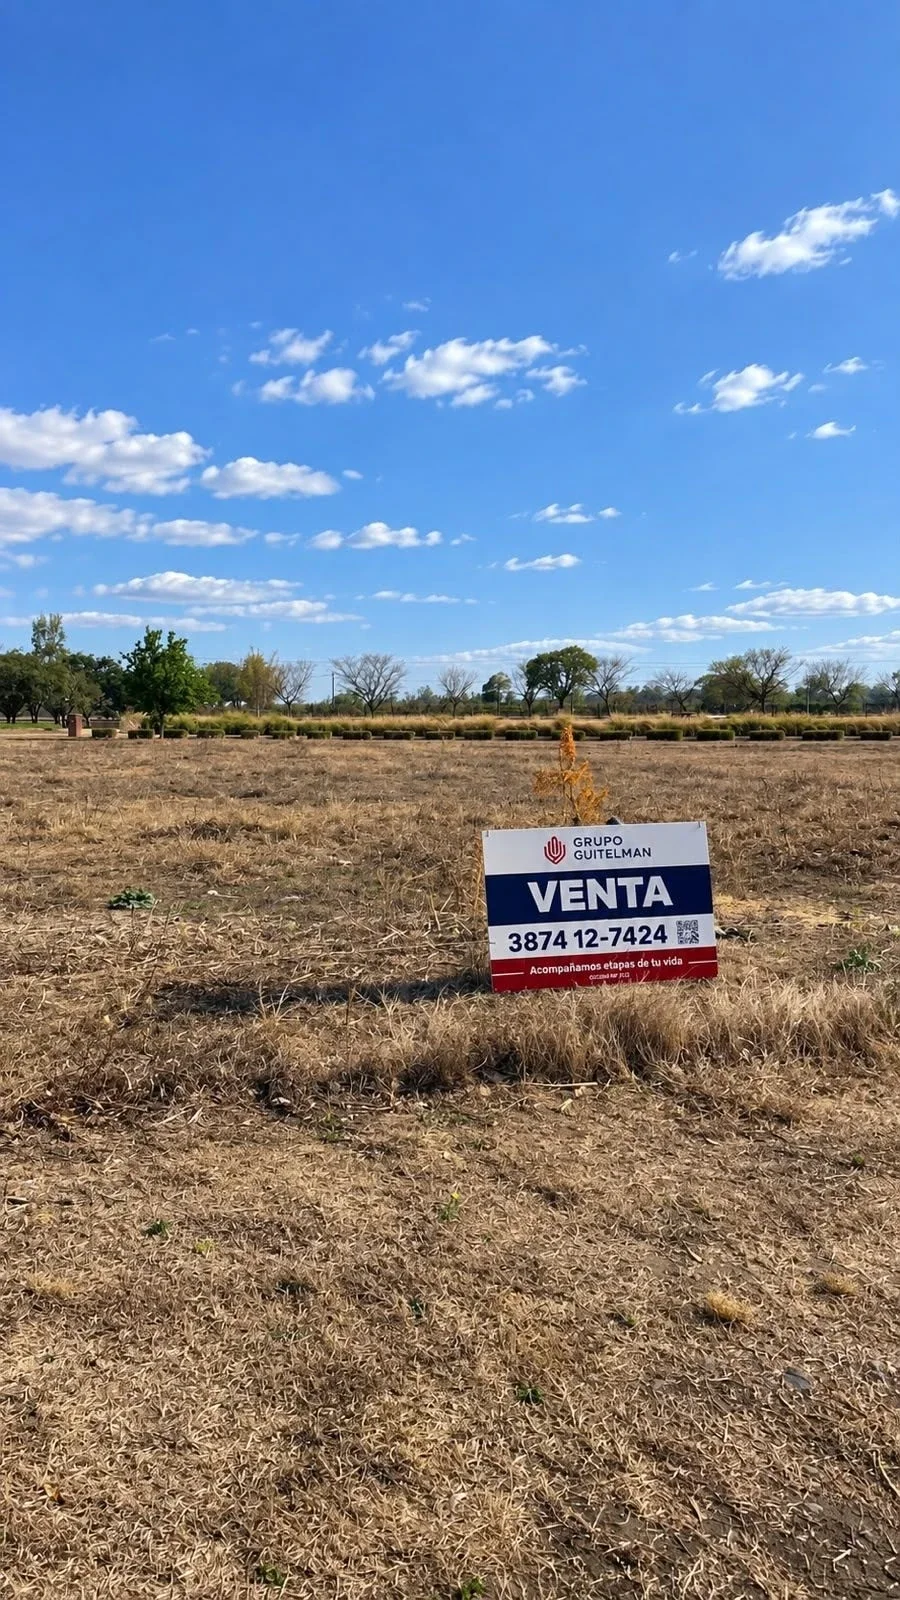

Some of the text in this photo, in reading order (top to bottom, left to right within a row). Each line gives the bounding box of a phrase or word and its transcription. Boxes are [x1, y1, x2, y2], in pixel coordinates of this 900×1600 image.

[573, 835, 623, 847] GRUPO
[573, 847, 652, 860] GUITELMAN
[527, 875, 674, 913] VENTA
[508, 924, 668, 953] 3874 12-7424
[530, 956, 683, 975] Acompañamos etapas de tu vida
